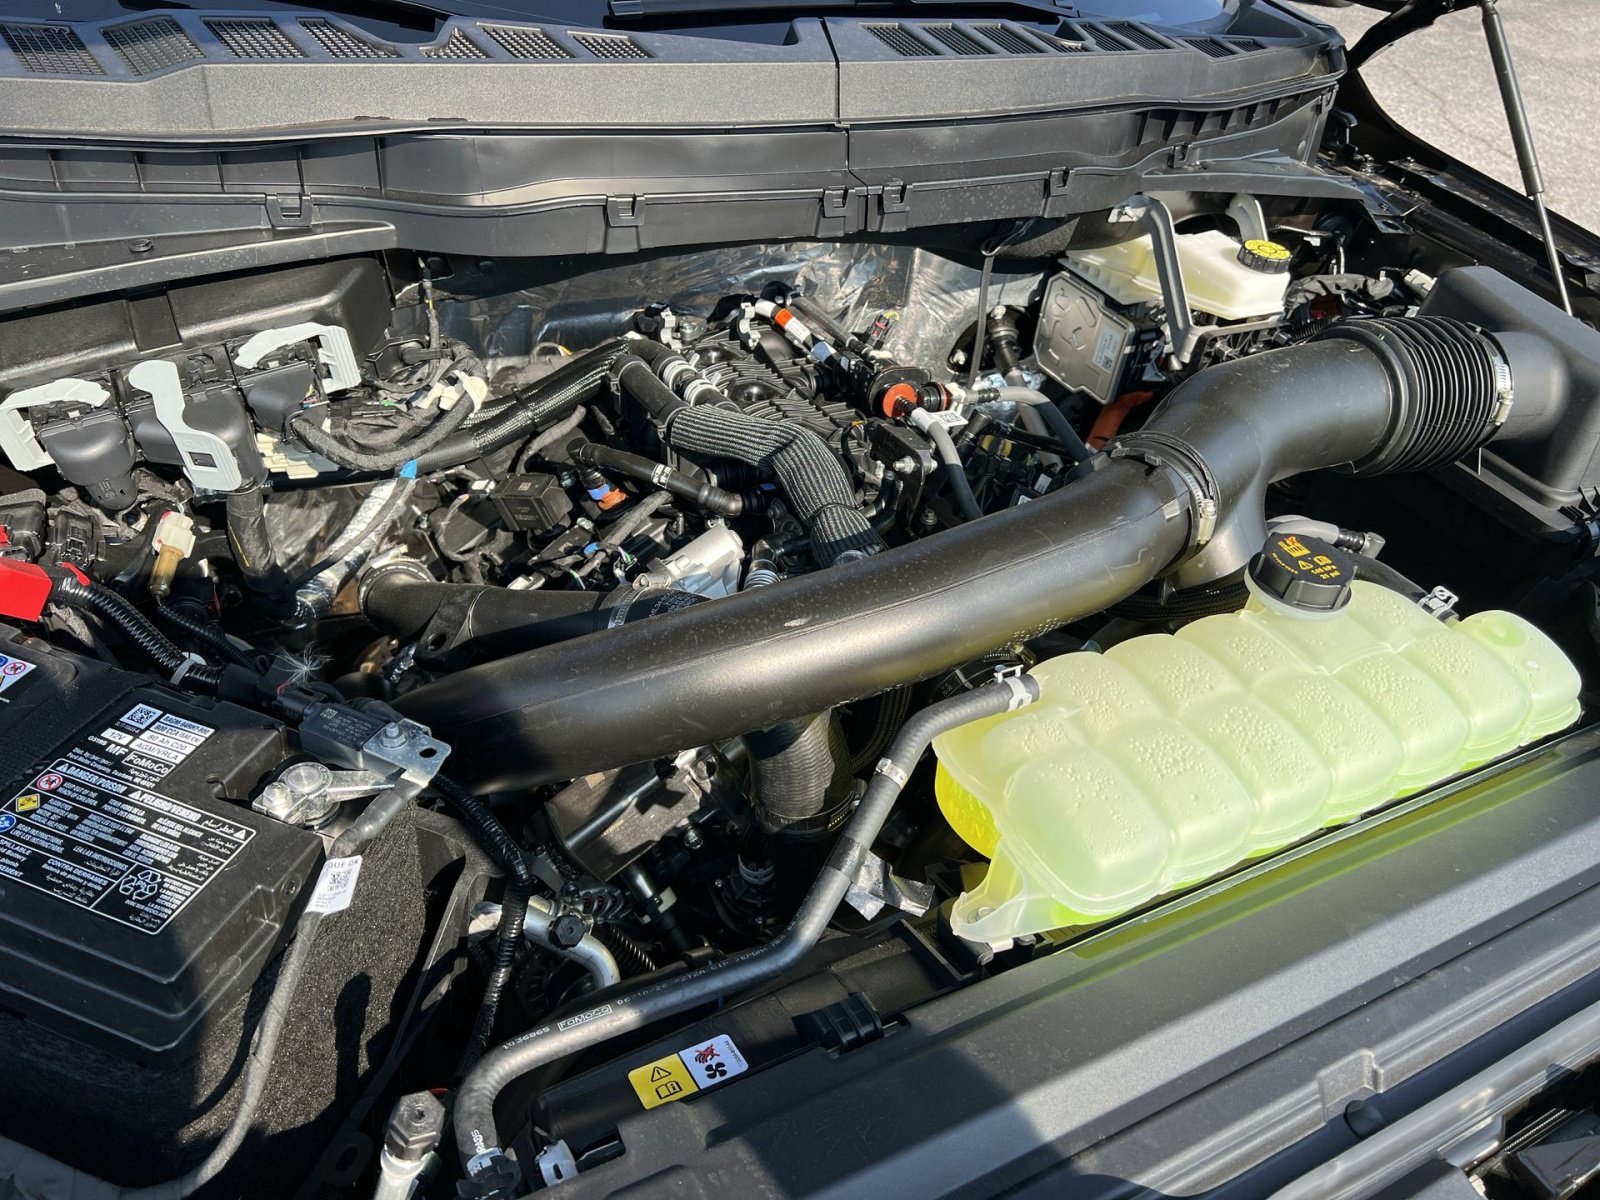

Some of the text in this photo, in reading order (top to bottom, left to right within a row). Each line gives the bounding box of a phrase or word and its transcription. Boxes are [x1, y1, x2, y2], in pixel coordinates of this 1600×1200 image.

[110, 732, 126, 740] 12V
[105, 744, 129, 755] MF
[136, 743, 178, 760] AGM/VRLA
[170, 742, 187, 750] C20
[125, 753, 168, 774] FoMoCo
[66, 766, 128, 794] DANGER/POISON
[140, 793, 201, 821] PELIGRO/VENENO
[6, 849, 28, 862] Battery
[48, 858, 108, 886] CONTRA DERRAMES
[560, 1006, 610, 1029] FoMoCo
